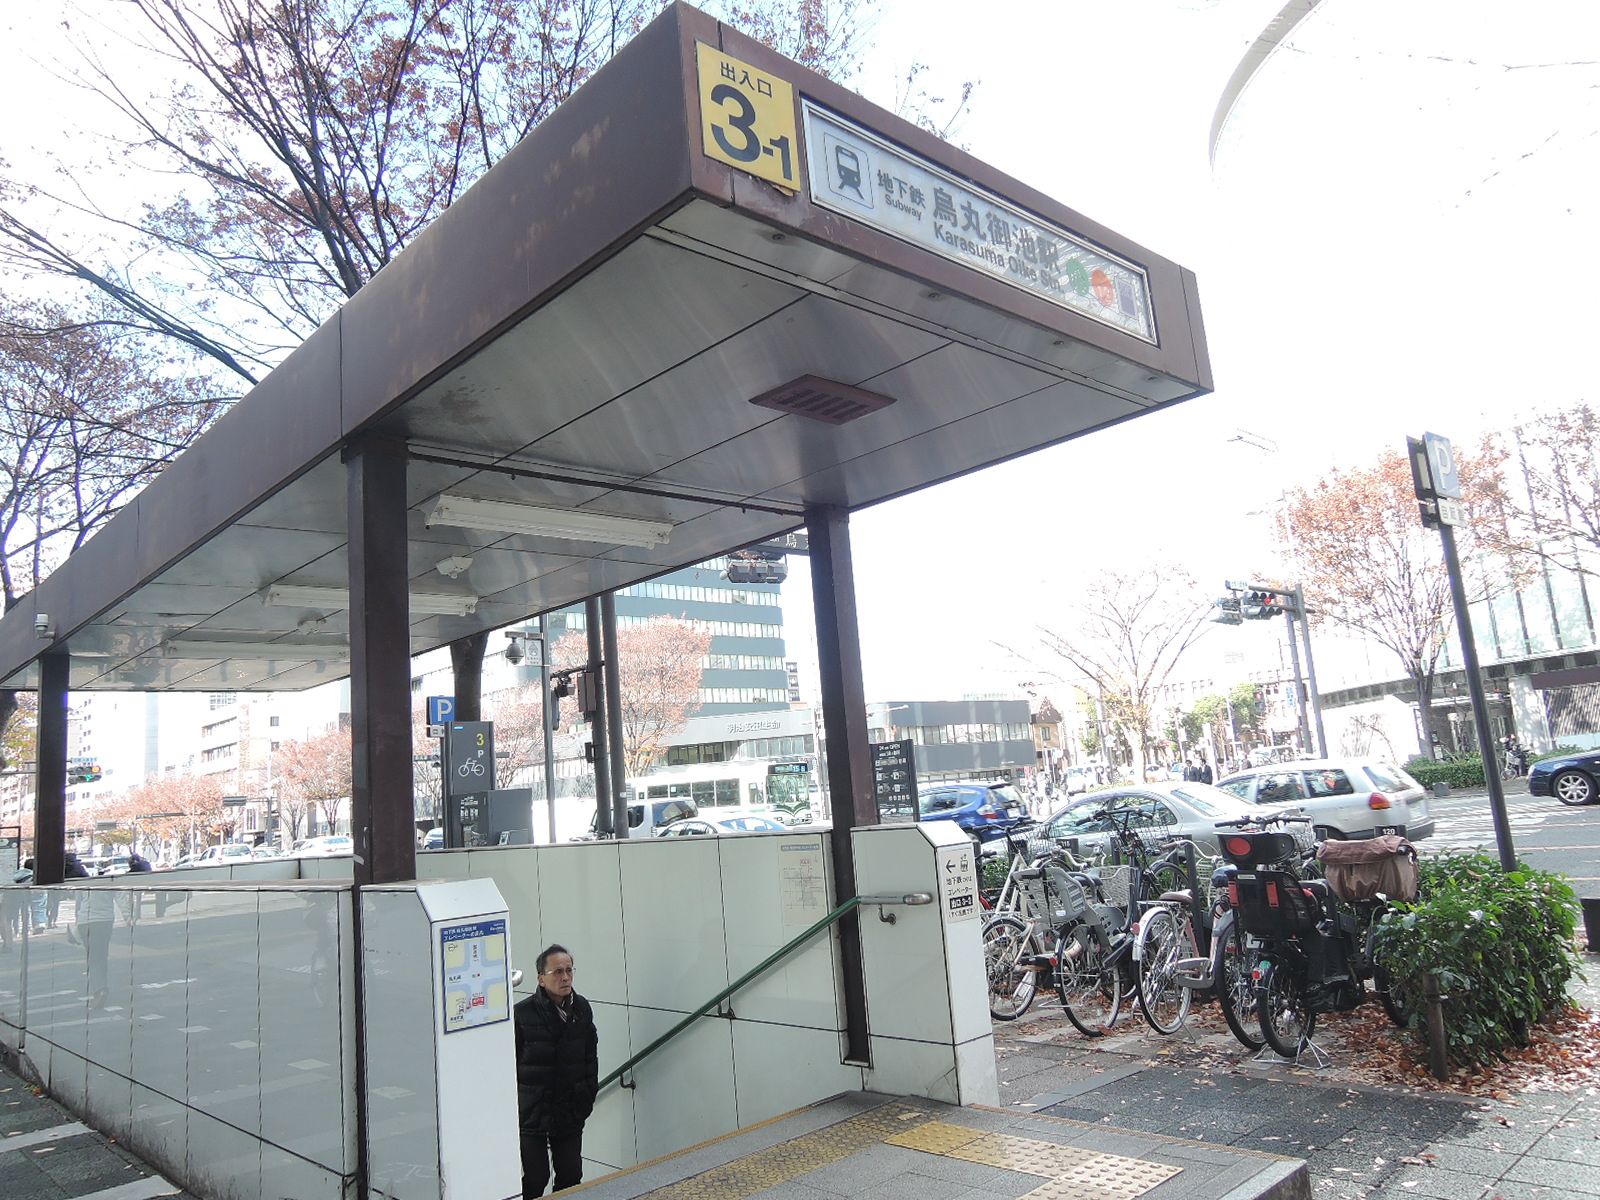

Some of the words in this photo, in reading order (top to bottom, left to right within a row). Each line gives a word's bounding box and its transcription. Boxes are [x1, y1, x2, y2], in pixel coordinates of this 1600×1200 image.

[721, 61, 773, 98] 出入口
[711, 84, 792, 181] 3-1
[877, 169, 926, 209] 地下鉄
[933, 187, 1061, 273] 烏丸御池駅
[885, 194, 922, 221] Subway
[934, 221, 1005, 267] Karasuma
[1008, 255, 1037, 282] Oike
[1433, 440, 1451, 490] P
[437, 699, 452, 722] P
[476, 733, 484, 746] 3
[478, 750, 484, 758] P
